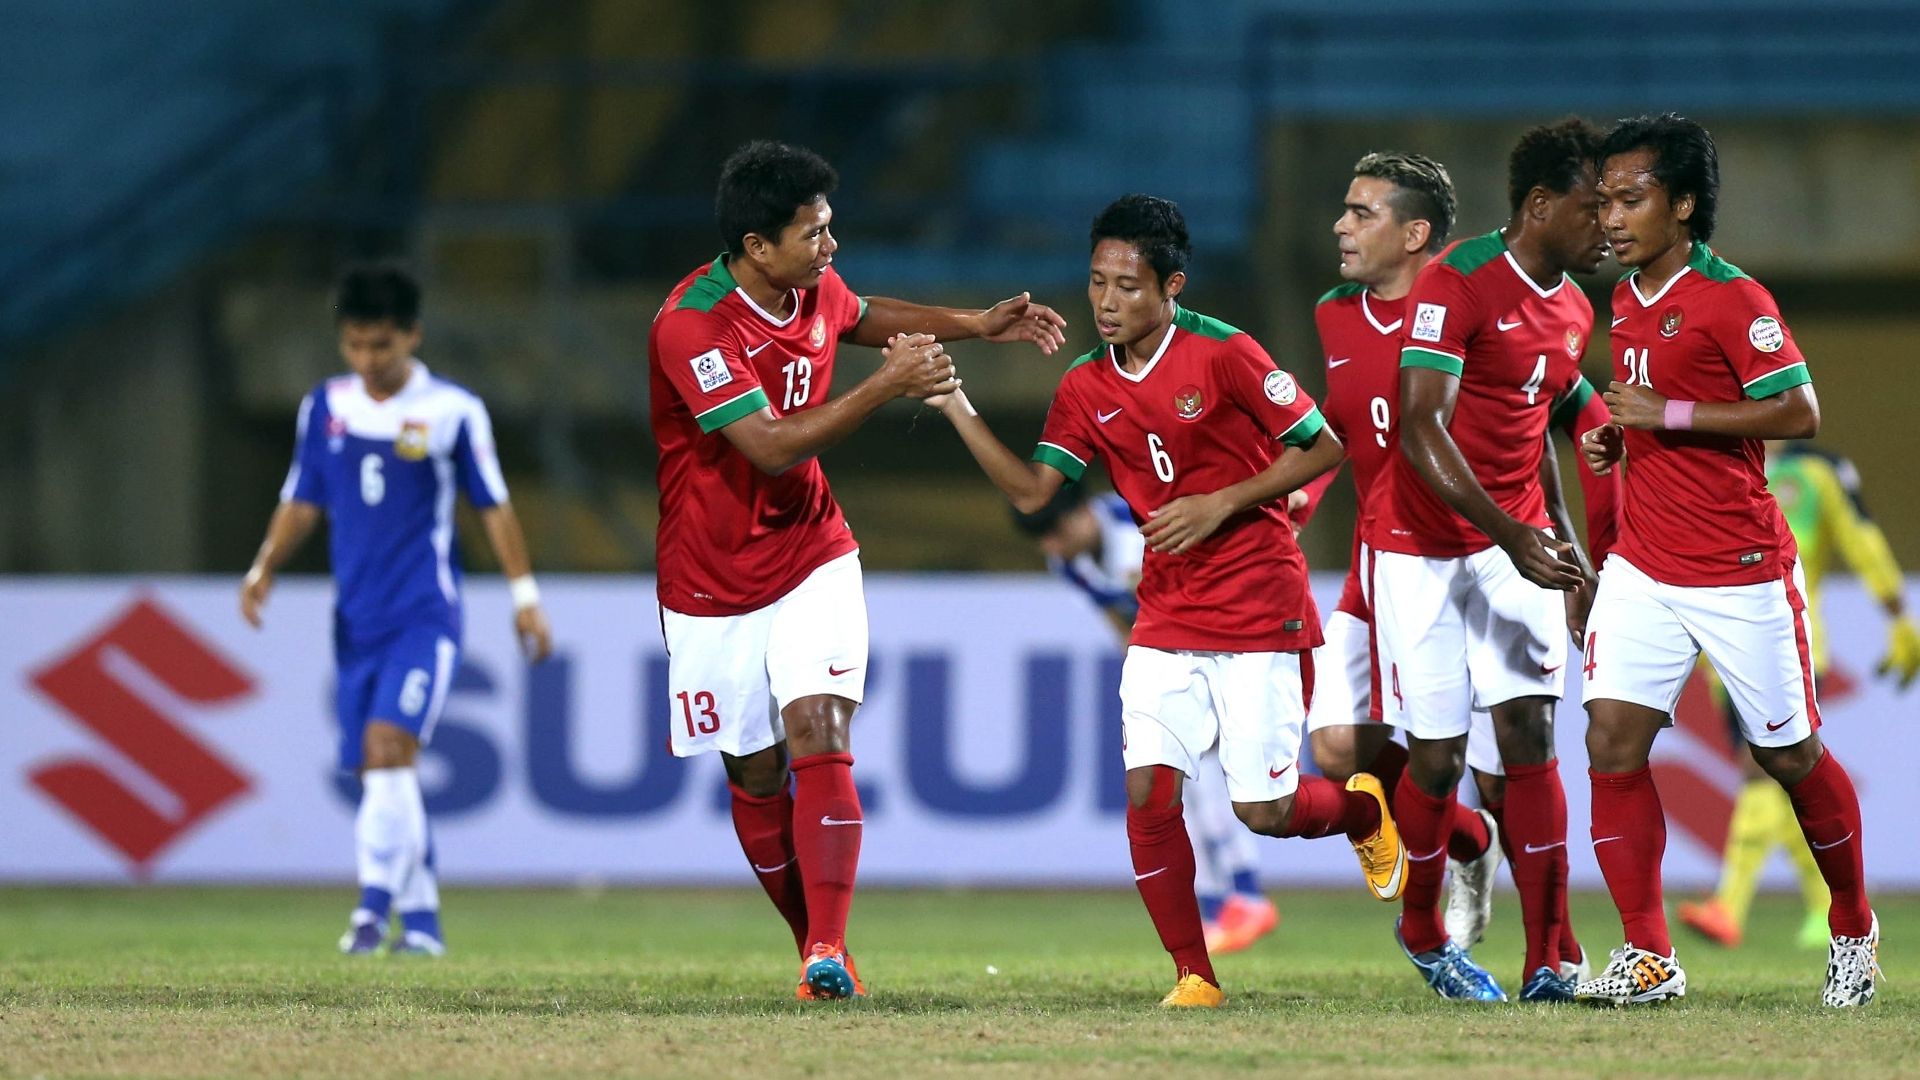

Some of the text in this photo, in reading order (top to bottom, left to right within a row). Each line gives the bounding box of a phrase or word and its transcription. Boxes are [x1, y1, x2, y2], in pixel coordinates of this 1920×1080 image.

[781, 355, 812, 411] 13
[1521, 354, 1547, 404] 4
[1623, 347, 1654, 389] 24
[1370, 396, 1390, 448] 9
[359, 452, 386, 507] 6
[1147, 433, 1175, 482] 6
[398, 668, 431, 717] 6
[676, 690, 720, 737] 13
